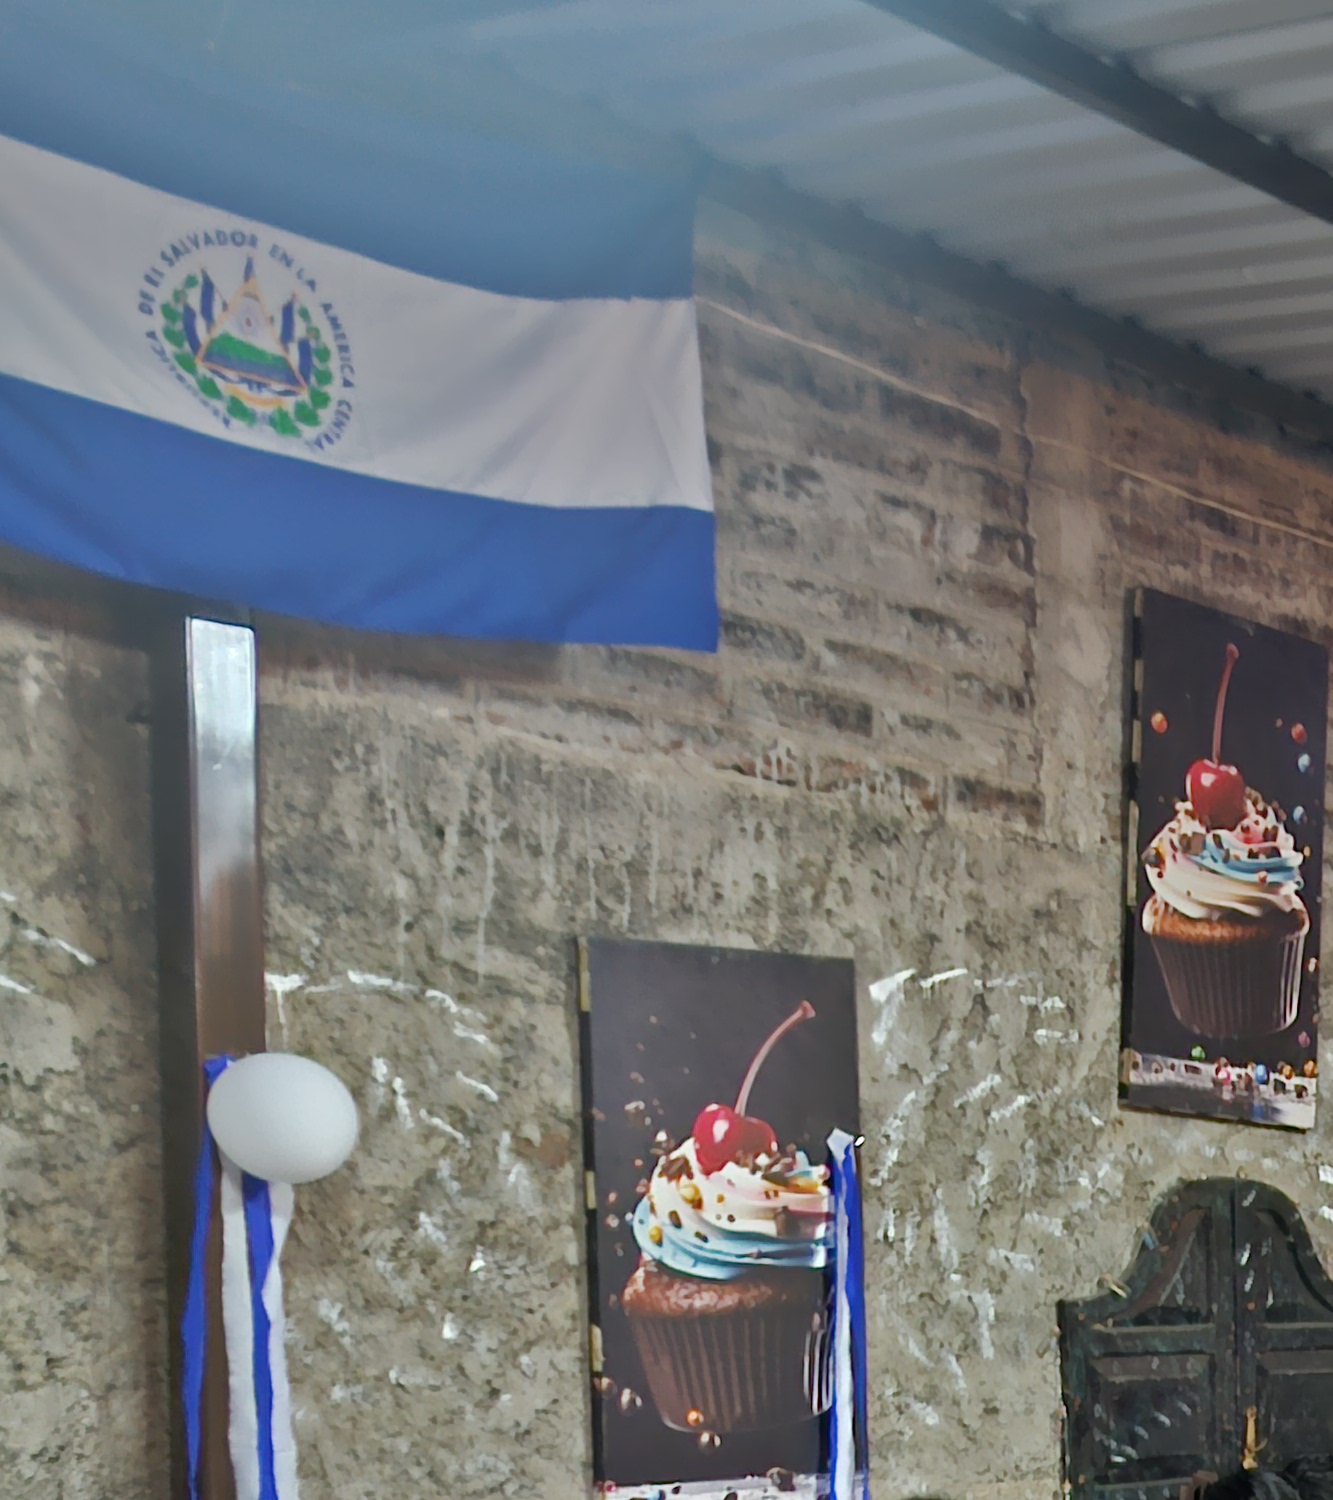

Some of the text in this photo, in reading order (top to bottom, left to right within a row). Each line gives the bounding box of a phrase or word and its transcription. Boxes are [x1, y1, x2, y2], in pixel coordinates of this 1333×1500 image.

[160, 229, 259, 267] SALVADOR
[269, 243, 294, 268] EN
[321, 302, 355, 388] AMERICA
